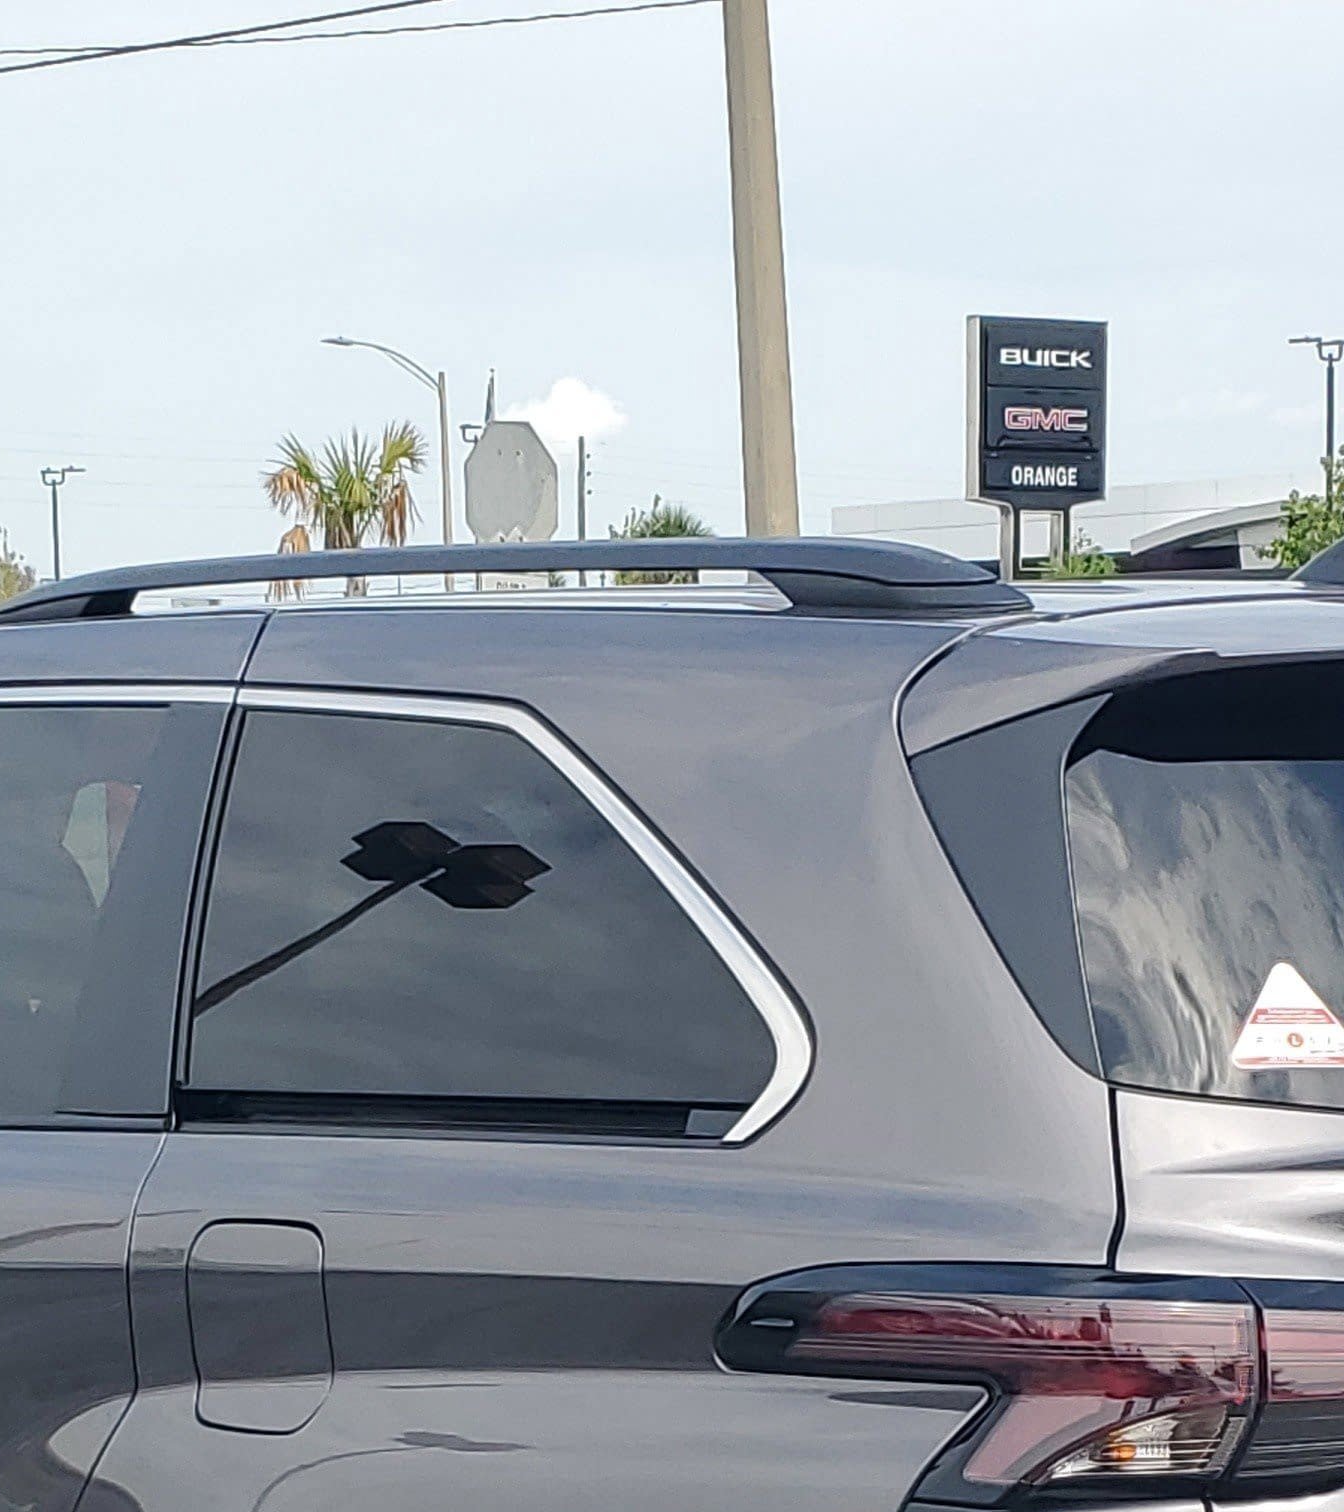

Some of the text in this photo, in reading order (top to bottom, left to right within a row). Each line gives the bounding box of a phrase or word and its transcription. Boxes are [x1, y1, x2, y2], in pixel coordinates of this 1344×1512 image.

[999, 347, 1093, 369] BUICK
[1004, 406, 1089, 432] GMC
[1011, 465, 1079, 488] ORANGE
